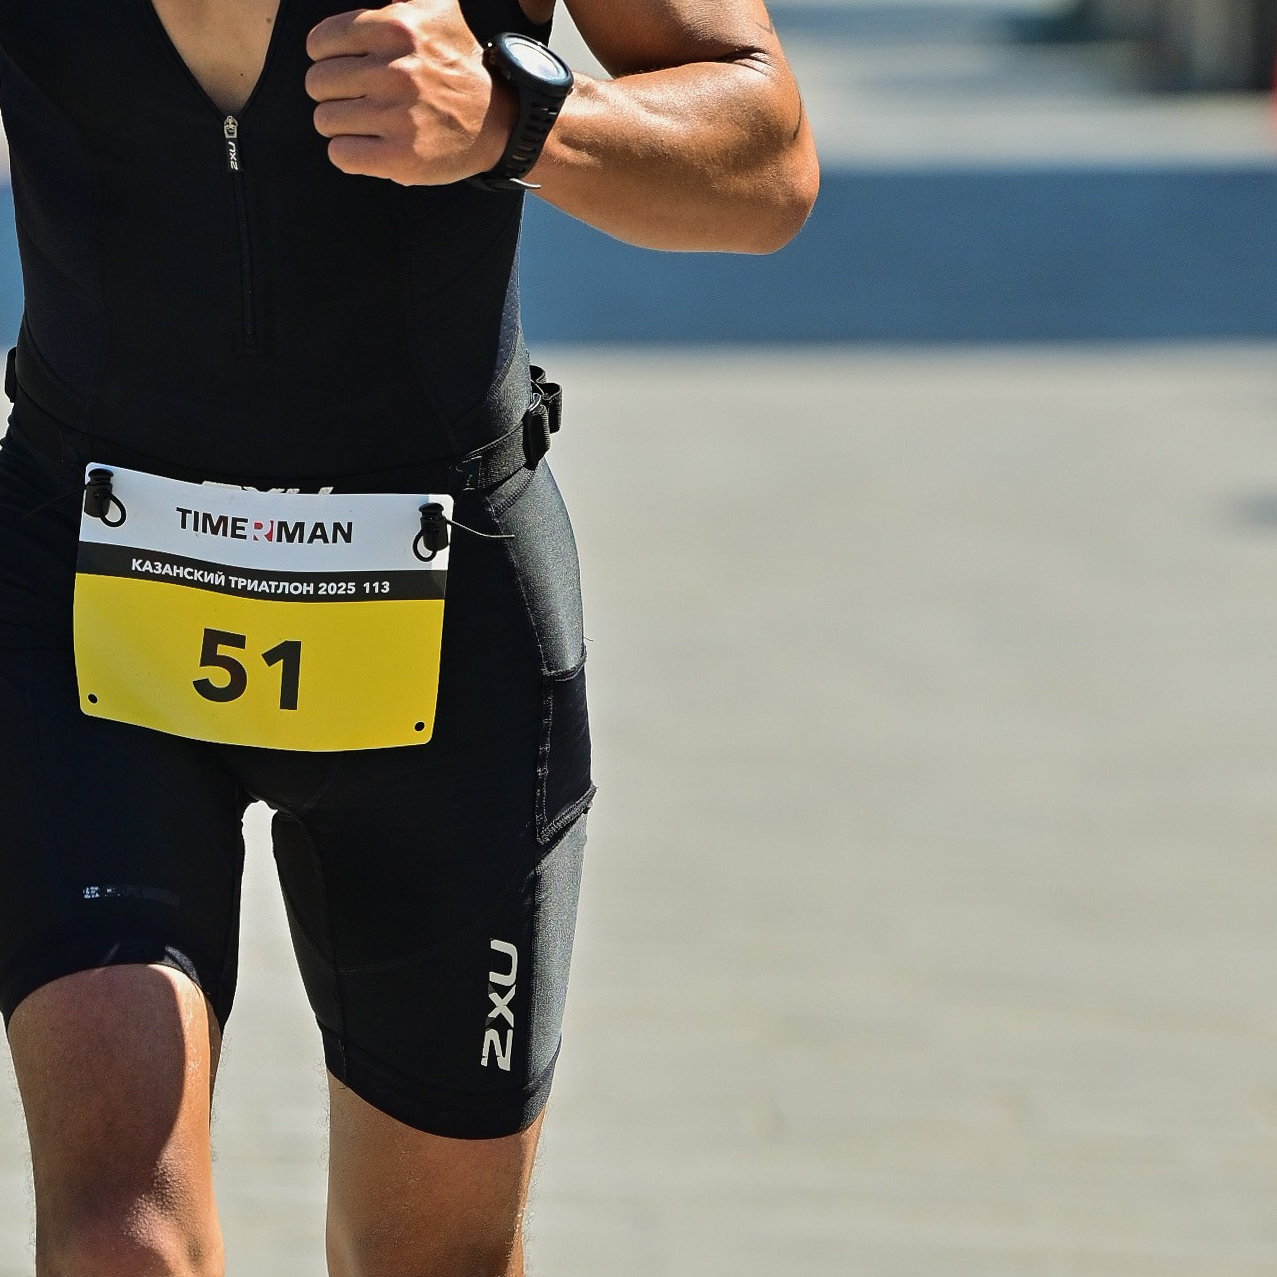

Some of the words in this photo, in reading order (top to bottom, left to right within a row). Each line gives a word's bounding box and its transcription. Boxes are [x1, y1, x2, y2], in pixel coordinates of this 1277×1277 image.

[228, 141, 239, 171] 2XU
[131, 557, 226, 587] КАЗАНСКИЙ
[228, 576, 314, 596] ТРИАТЛОН
[318, 581, 356, 596] 2025
[362, 580, 390, 595] 113
[191, 627, 303, 711] 51
[480, 938, 519, 1072] 2XU
